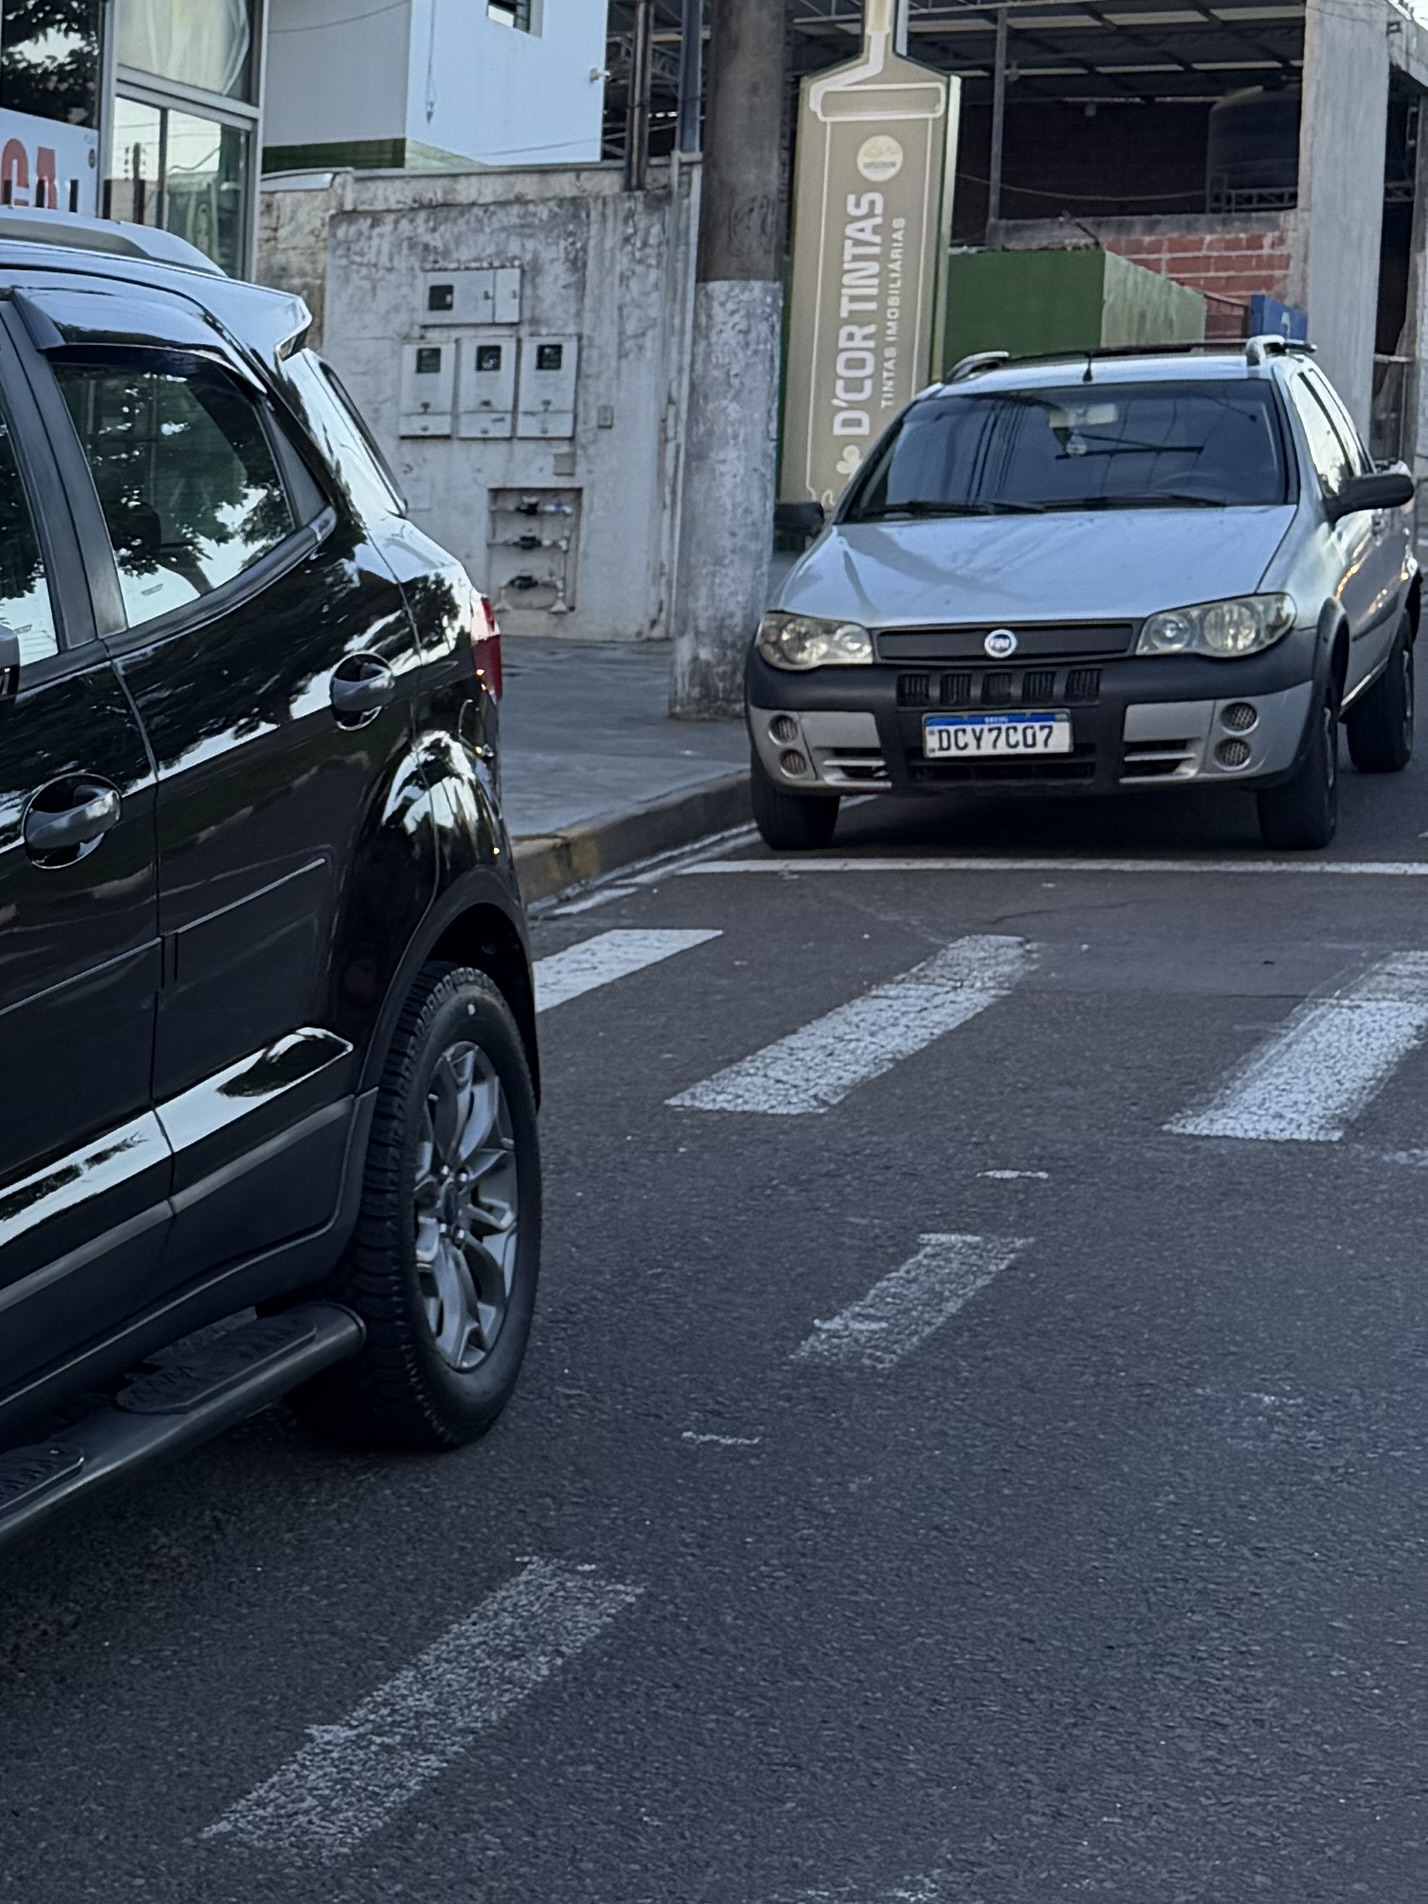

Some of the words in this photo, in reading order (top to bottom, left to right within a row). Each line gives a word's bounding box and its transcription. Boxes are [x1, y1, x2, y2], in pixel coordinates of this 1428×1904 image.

[840, 191, 884, 319] TINTAS
[884, 217, 906, 342] IMOBILIÁRIAS
[831, 324, 878, 436] D'COR
[881, 346, 897, 409] TINTAS
[937, 725, 1054, 752] DCY7C07
